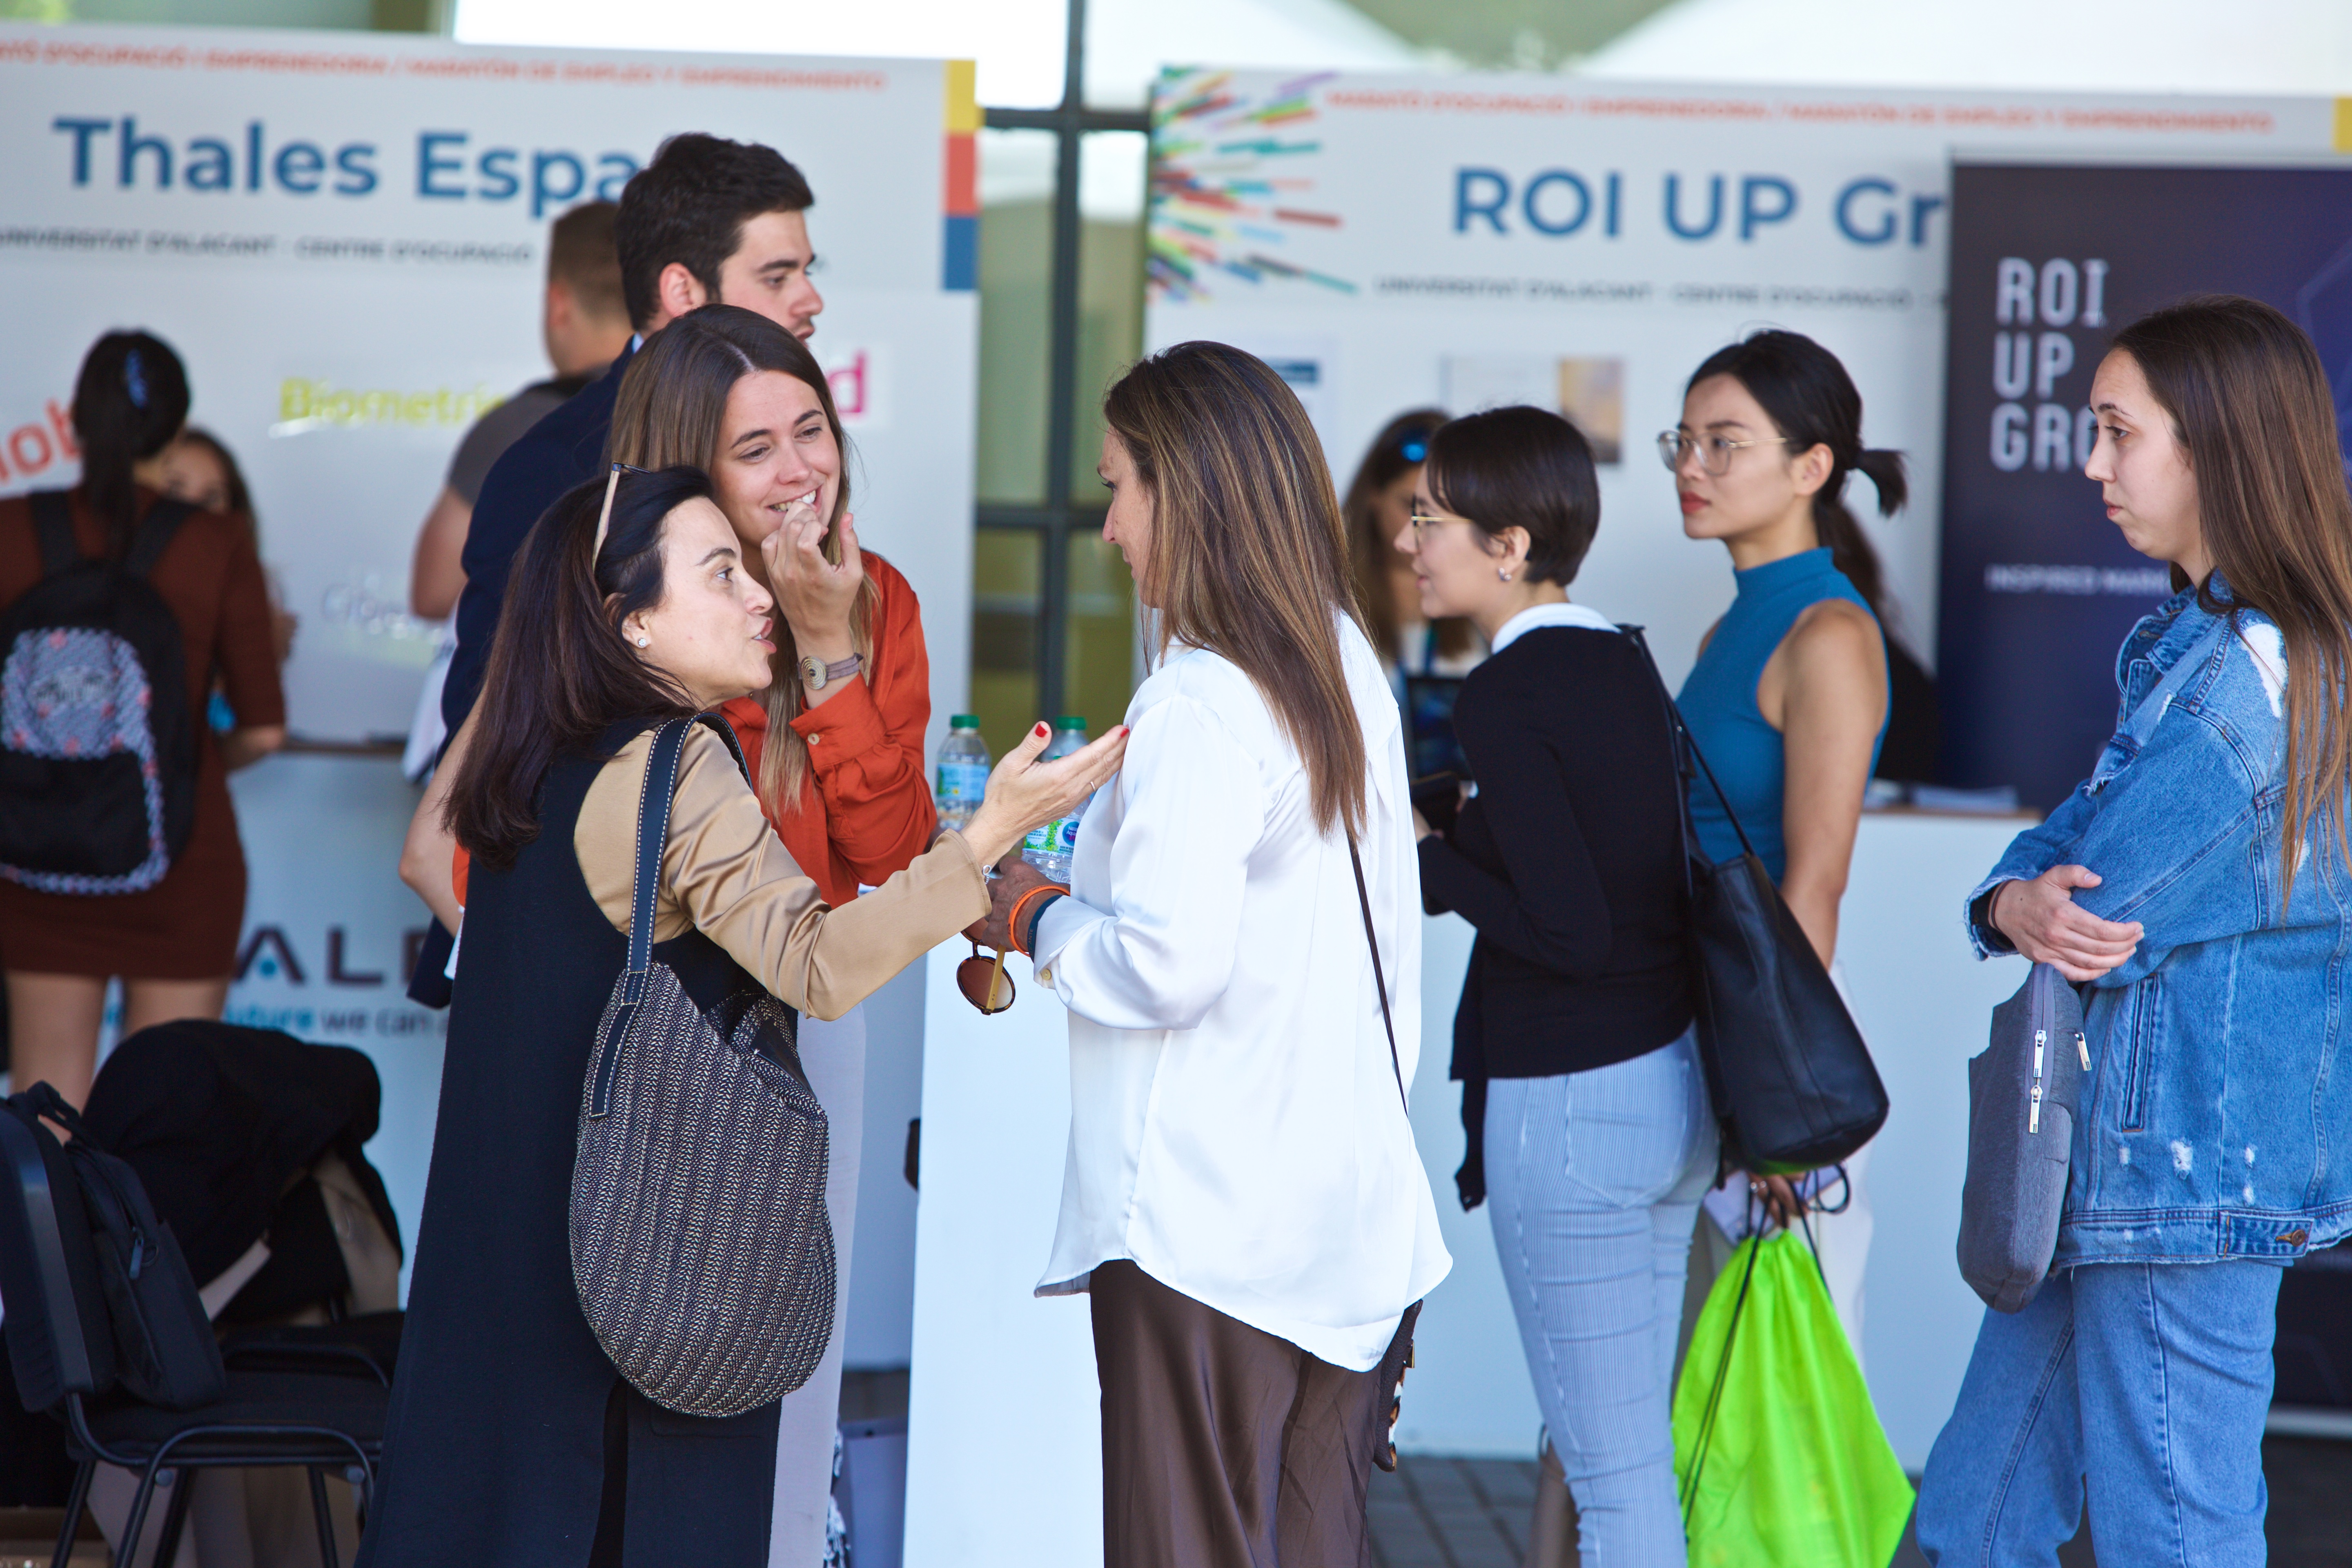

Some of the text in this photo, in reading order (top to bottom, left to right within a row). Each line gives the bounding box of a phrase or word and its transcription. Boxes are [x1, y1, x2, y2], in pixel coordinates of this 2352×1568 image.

[51, 116, 380, 196] Thales
[1453, 166, 1949, 247] ROI UP Gr
[1996, 257, 2109, 328] ROI
[1993, 332, 2075, 400] UP
